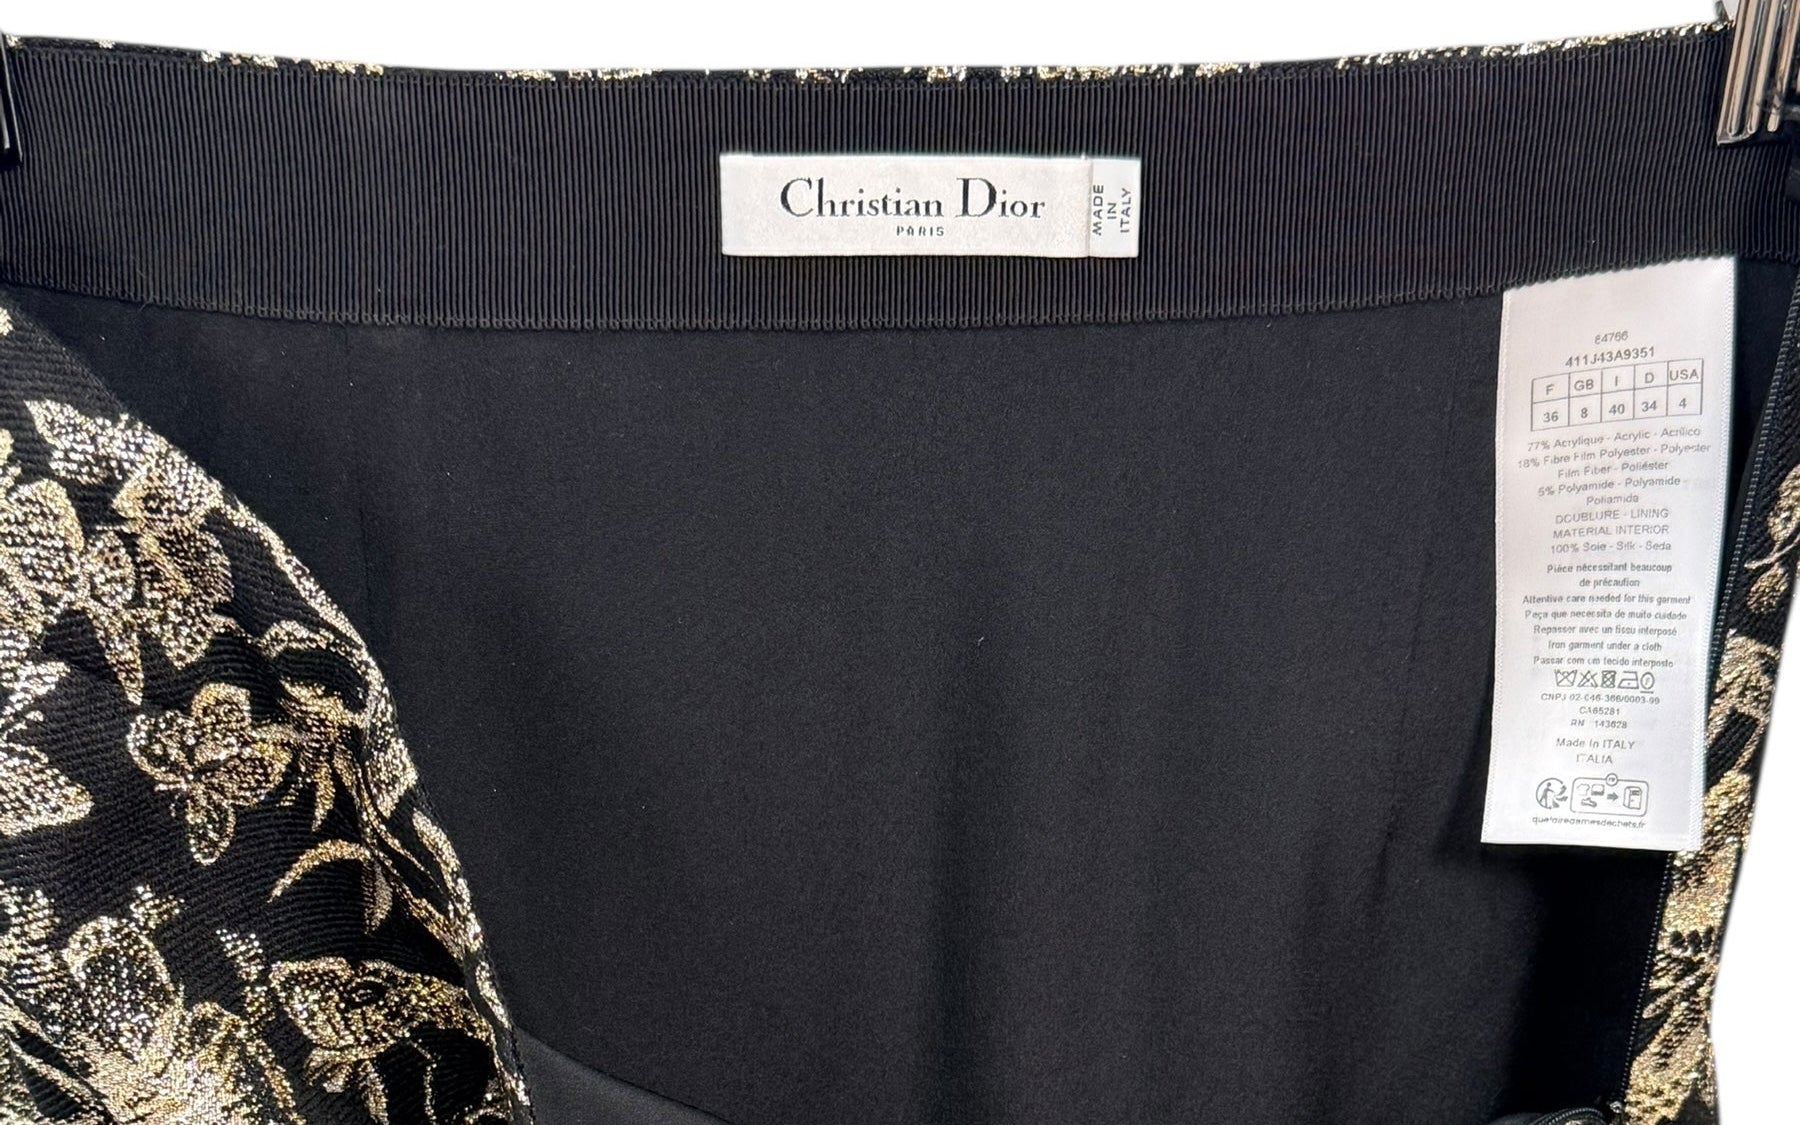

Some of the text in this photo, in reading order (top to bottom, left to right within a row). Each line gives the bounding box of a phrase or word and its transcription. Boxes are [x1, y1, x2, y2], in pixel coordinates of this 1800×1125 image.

[780, 177, 1046, 219] Christian Dior
[1092, 184, 1104, 236] MADE
[1107, 202, 1117, 220] IN
[1120, 187, 1132, 233] ITALY
[896, 226, 945, 237] PARIS
[1565, 346, 1655, 367] 411J43A9351
[1546, 369, 1699, 395] F GB I D USA
[1543, 398, 1687, 423] 36 8 40 34 4
[1527, 440, 1550, 451] 77%
[1553, 435, 1604, 448] Acrylique
[1614, 431, 1650, 443] Acrylic
[1518, 456, 1540, 468] 18%
[1543, 453, 1570, 465] Fibre
[1574, 451, 1595, 462] Film
[1600, 446, 1650, 460] Polyester
[1660, 444, 1711, 455] Polyester
[1558, 468, 1579, 479] Film
[1584, 465, 1610, 475] Fiber
[1538, 485, 1555, 497] 5%
[1558, 479, 1614, 494] Polyamide
[1625, 476, 1681, 489] Polyamide
[1587, 494, 1639, 506] Poliamida
[1630, 508, 1669, 518] LINING
[1553, 525, 1669, 539] MATERIAL INTERIOR
[1551, 543, 1579, 554] 100%
[1584, 541, 1606, 551] Soie
[1616, 540, 1635, 550] Silk
[1647, 540, 1671, 550] Seda
[1630, 563, 1672, 573] beaucoup
[1579, 577, 1640, 589] de précaution
[1522, 594, 1690, 605] Attentive care needed for this garment
[1551, 610, 1567, 619] que
[1570, 610, 1612, 618] necessita
[1615, 610, 1625, 618] de
[1628, 610, 1651, 619] muito
[1655, 611, 1687, 620] cuidado
[1534, 625, 1575, 635] Repasser
[1615, 625, 1635, 634] tissu
[1548, 640, 1566, 649] Iron
[1569, 641, 1603, 651] garment
[1606, 642, 1632, 650] under
[1642, 642, 1662, 651] cloth
[1534, 656, 1563, 665] Passar
[1567, 657, 1584, 665] com
[1603, 656, 1629, 666] tecido
[1632, 657, 1673, 668] interposto
[1541, 693, 1566, 701] CNPJ
[1571, 719, 1628, 729] RN 143628
[1556, 738, 1585, 748] Made
[1603, 739, 1635, 749] ITALY
[1576, 754, 1613, 764] ITALIA
